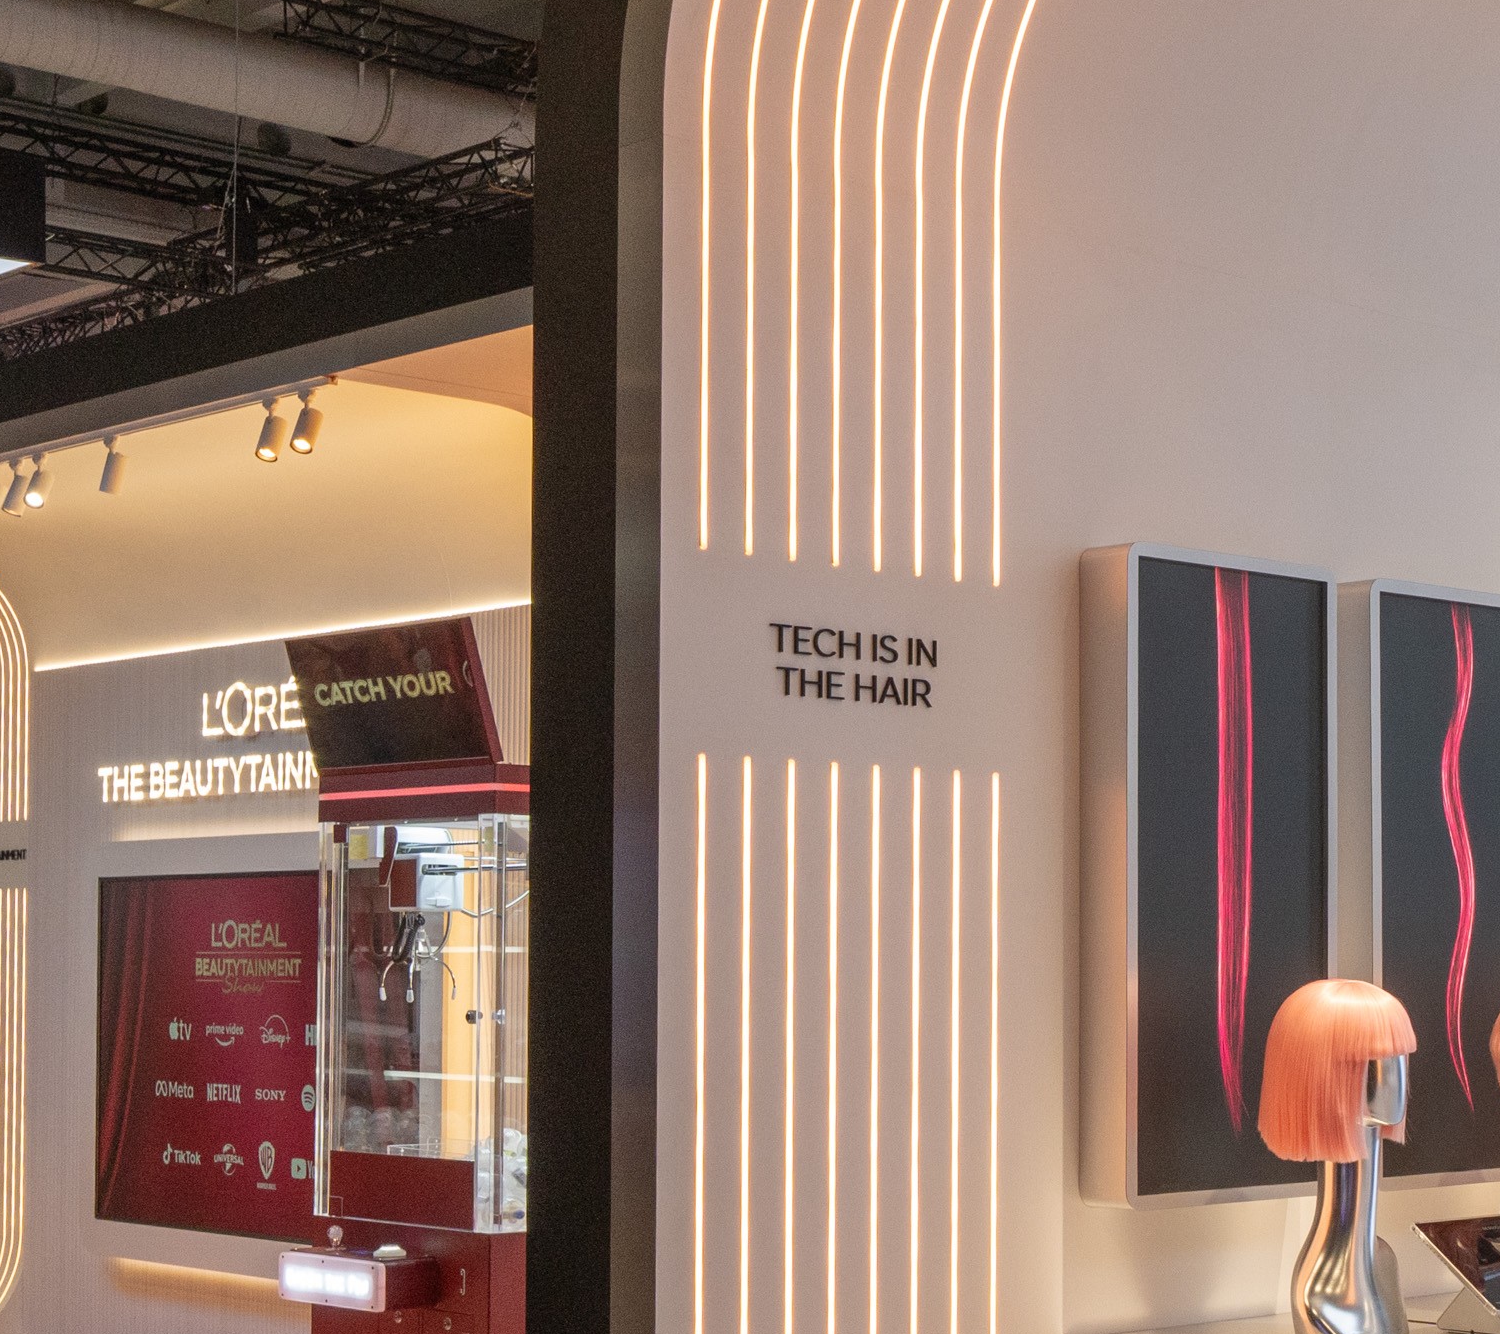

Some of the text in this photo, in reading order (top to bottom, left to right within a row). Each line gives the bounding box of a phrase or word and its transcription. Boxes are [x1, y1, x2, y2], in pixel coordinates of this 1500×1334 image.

[768, 622, 938, 668] TECH IS IN
[313, 670, 453, 708] CATCH YOUR
[775, 665, 933, 709] THE HAIR
[201, 674, 306, 737] L'ORÉ
[98, 764, 145, 803] THE
[210, 919, 287, 949] L'ORÉAL
[195, 957, 302, 977] BEAUTYTAINMENT
[205, 1022, 244, 1036] prime video
[168, 1081, 194, 1099] Meta
[206, 1082, 242, 1104] NETFLIX
[255, 1089, 286, 1101] SONY
[174, 1149, 202, 1165] TikTok
